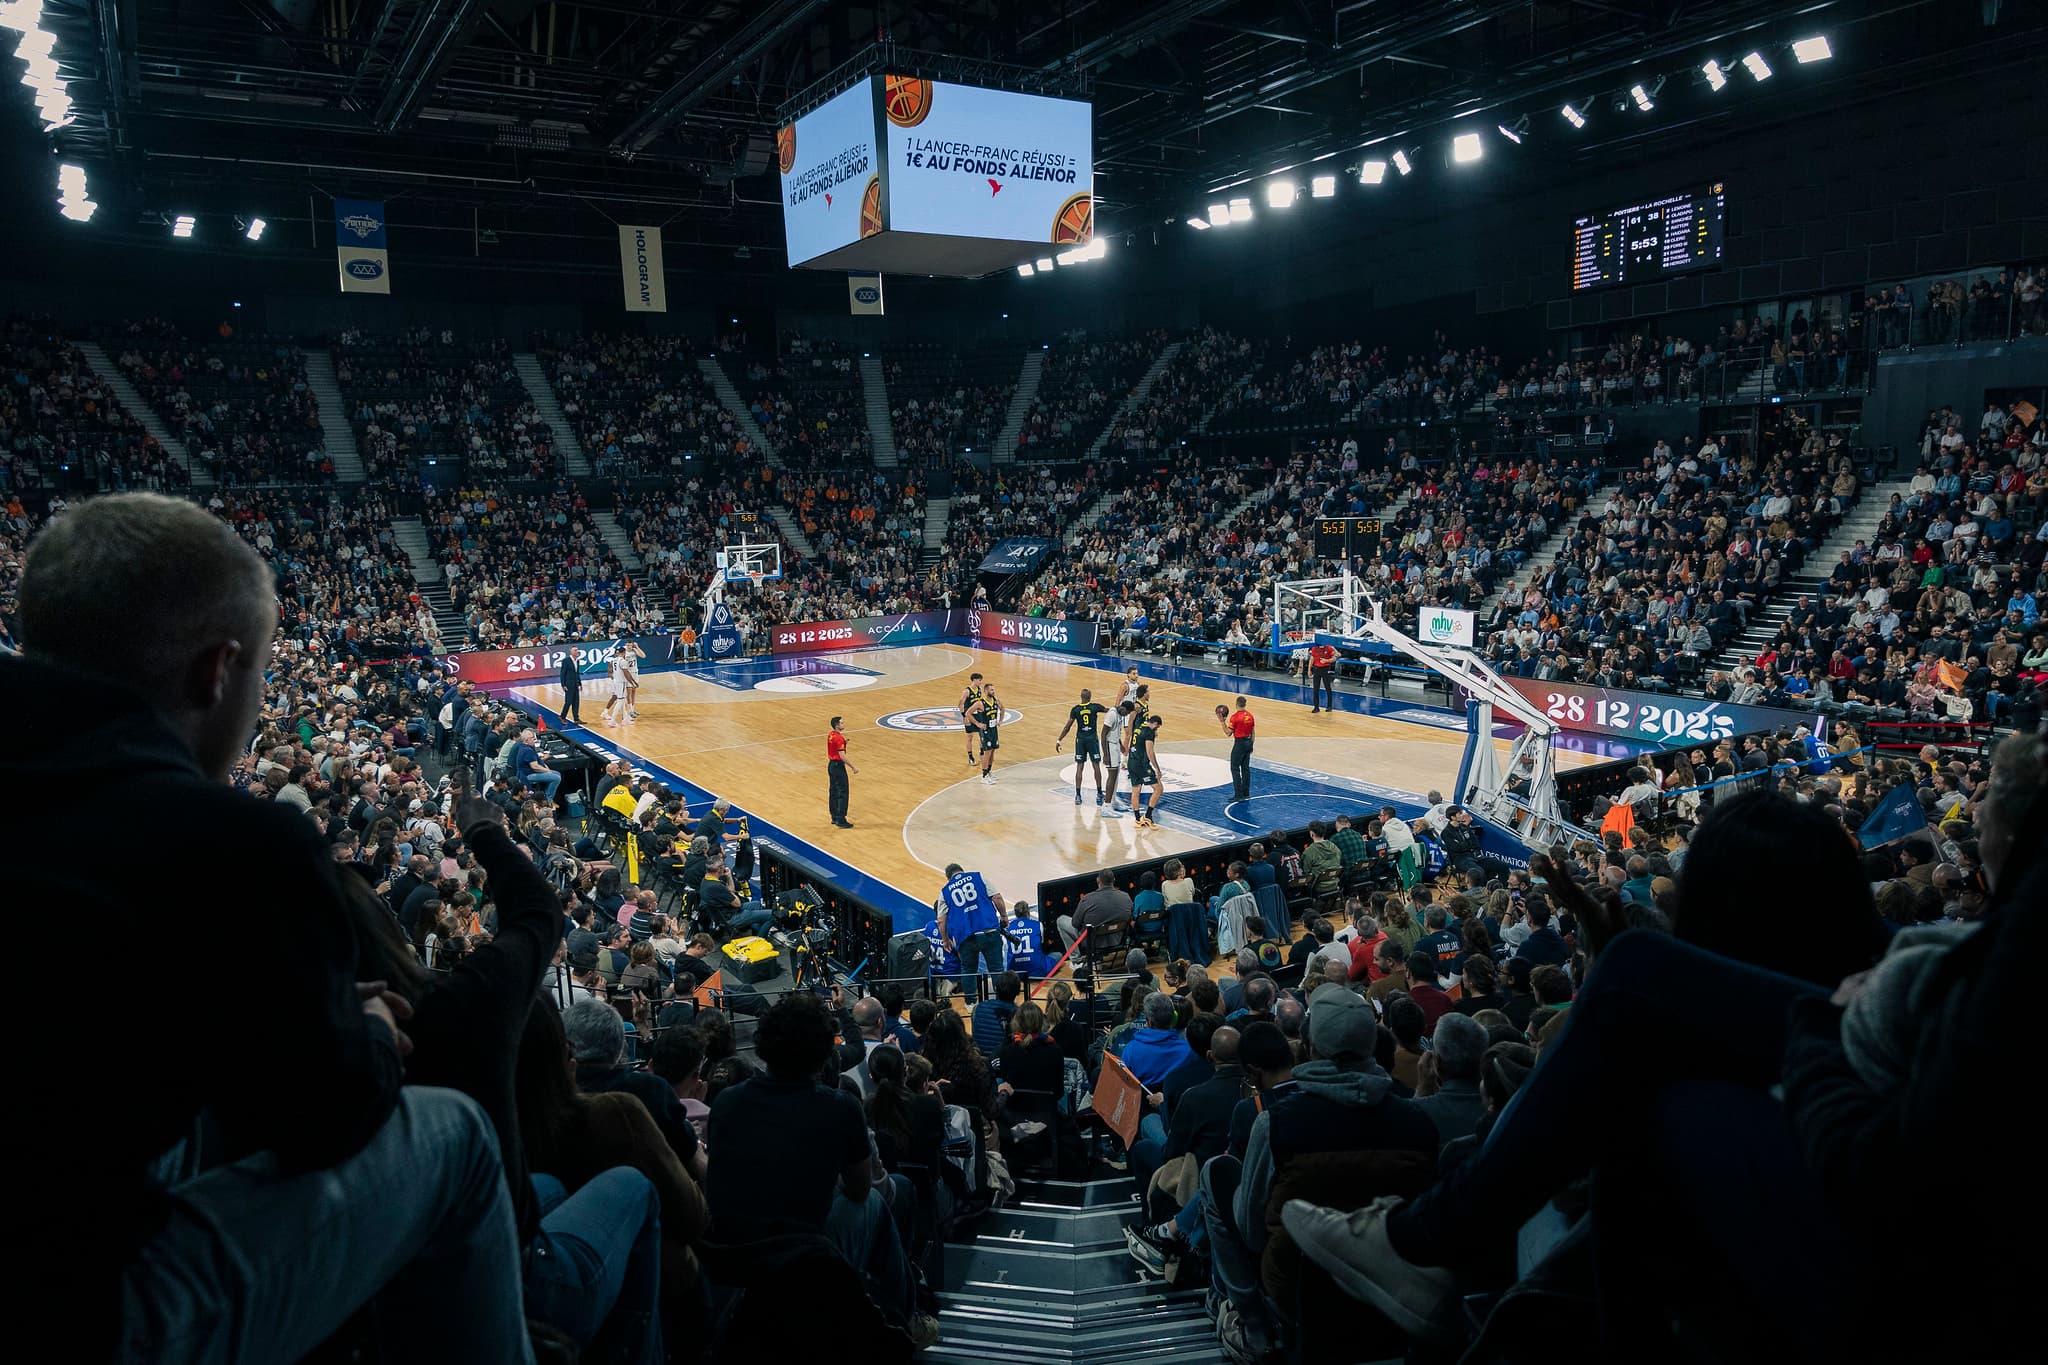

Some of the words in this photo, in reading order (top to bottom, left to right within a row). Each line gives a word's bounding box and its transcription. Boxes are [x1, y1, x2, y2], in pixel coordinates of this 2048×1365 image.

[906, 137, 912, 150] 1
[916, 138, 1018, 162] LANCER-FRANC
[1022, 149, 1066, 167] RÉUSSI
[792, 156, 838, 191] LANCER-FRANC
[838, 144, 862, 166] RÉUSSI
[906, 152, 924, 168] 1€
[926, 155, 950, 170] AU
[953, 158, 1006, 176] FONDS
[790, 191, 798, 207] 1€
[798, 186, 808, 204] AU
[810, 173, 833, 198] FONDS
[1654, 195, 1684, 208] ROCHELLE
[1630, 216, 1641, 224] 61
[1648, 212, 1658, 221] 38
[1630, 236, 1658, 250] 5:53
[1322, 522, 1344, 534] 5:53
[1357, 520, 1380, 534] 5:53
[1432, 611, 1454, 631] mhv
[780, 632, 797, 644] 28
[800, 630, 814, 643] 12
[818, 628, 853, 641] 2025
[1000, 619, 1015, 636] 28
[1018, 621, 1032, 639] 12
[1034, 623, 1068, 644] 2025
[948, 875, 972, 890] PHOTO
[951, 882, 978, 907] 08
[1008, 1229, 1026, 1239] H
